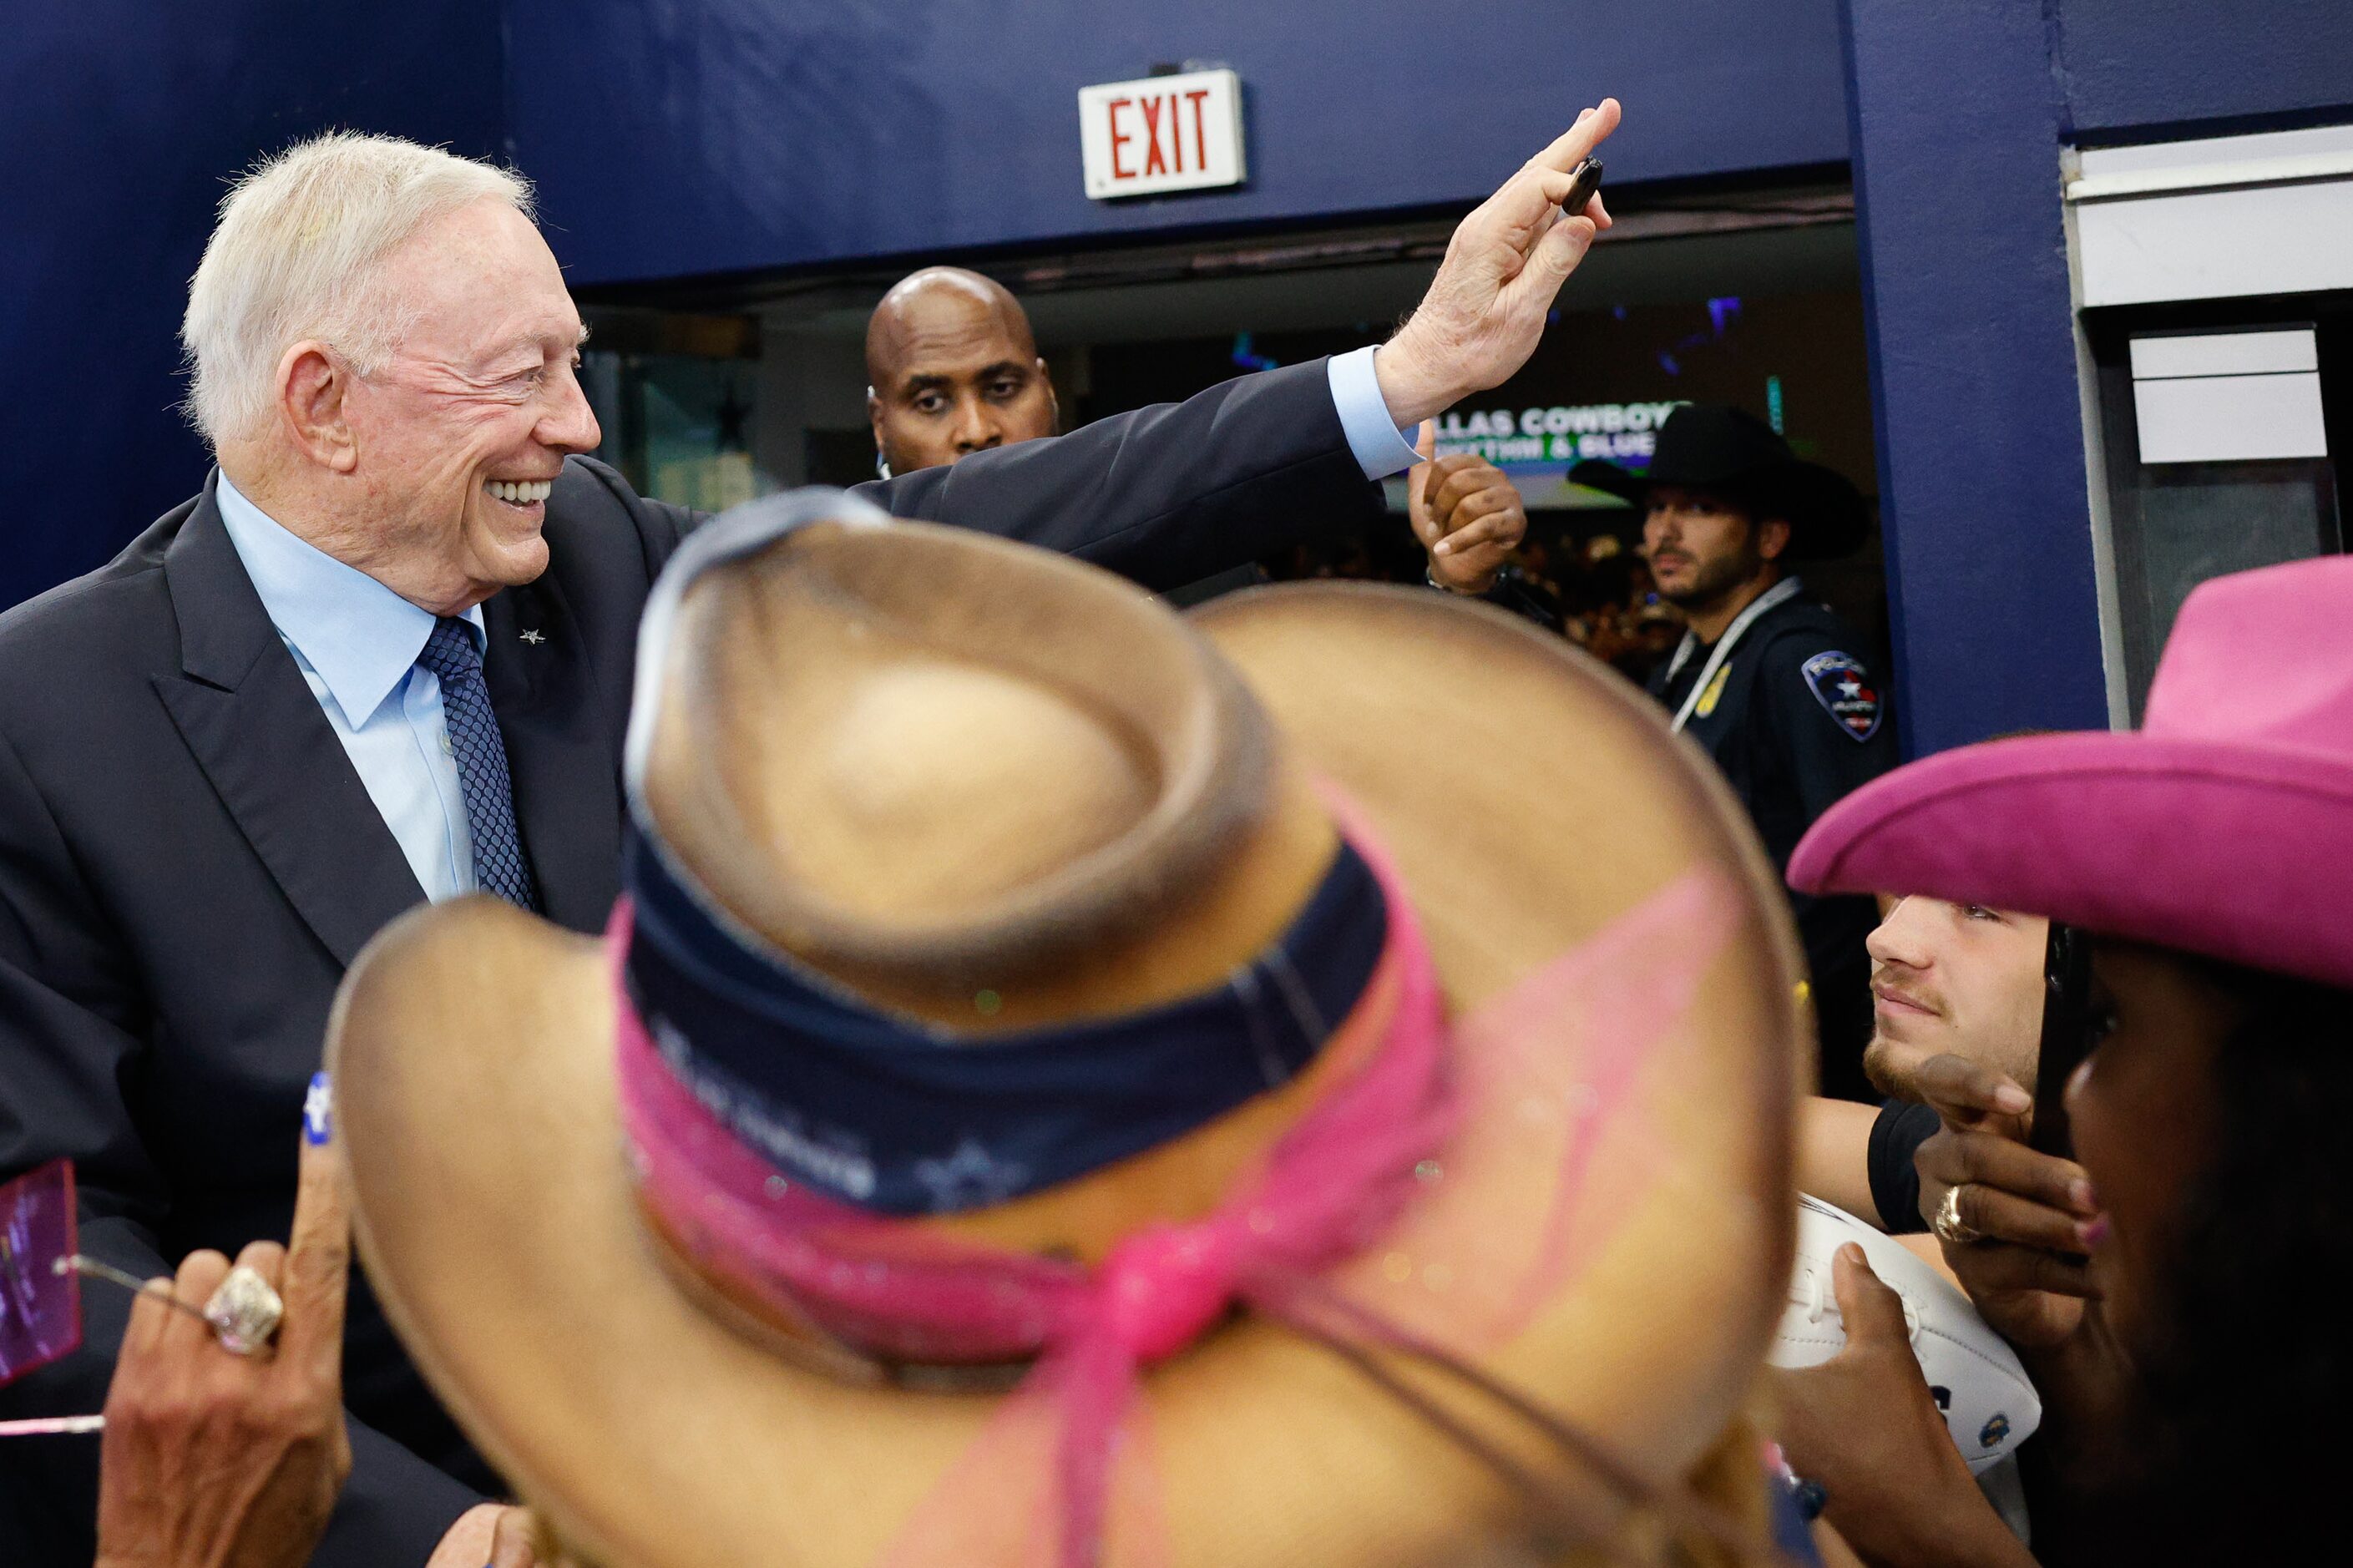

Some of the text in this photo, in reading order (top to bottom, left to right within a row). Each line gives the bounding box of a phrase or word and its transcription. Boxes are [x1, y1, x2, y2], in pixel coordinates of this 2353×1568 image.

[1109, 90, 1208, 179] EXIT
[1434, 401, 1693, 438] LLAS COWBOY
[1578, 432, 1656, 458] BLUE
